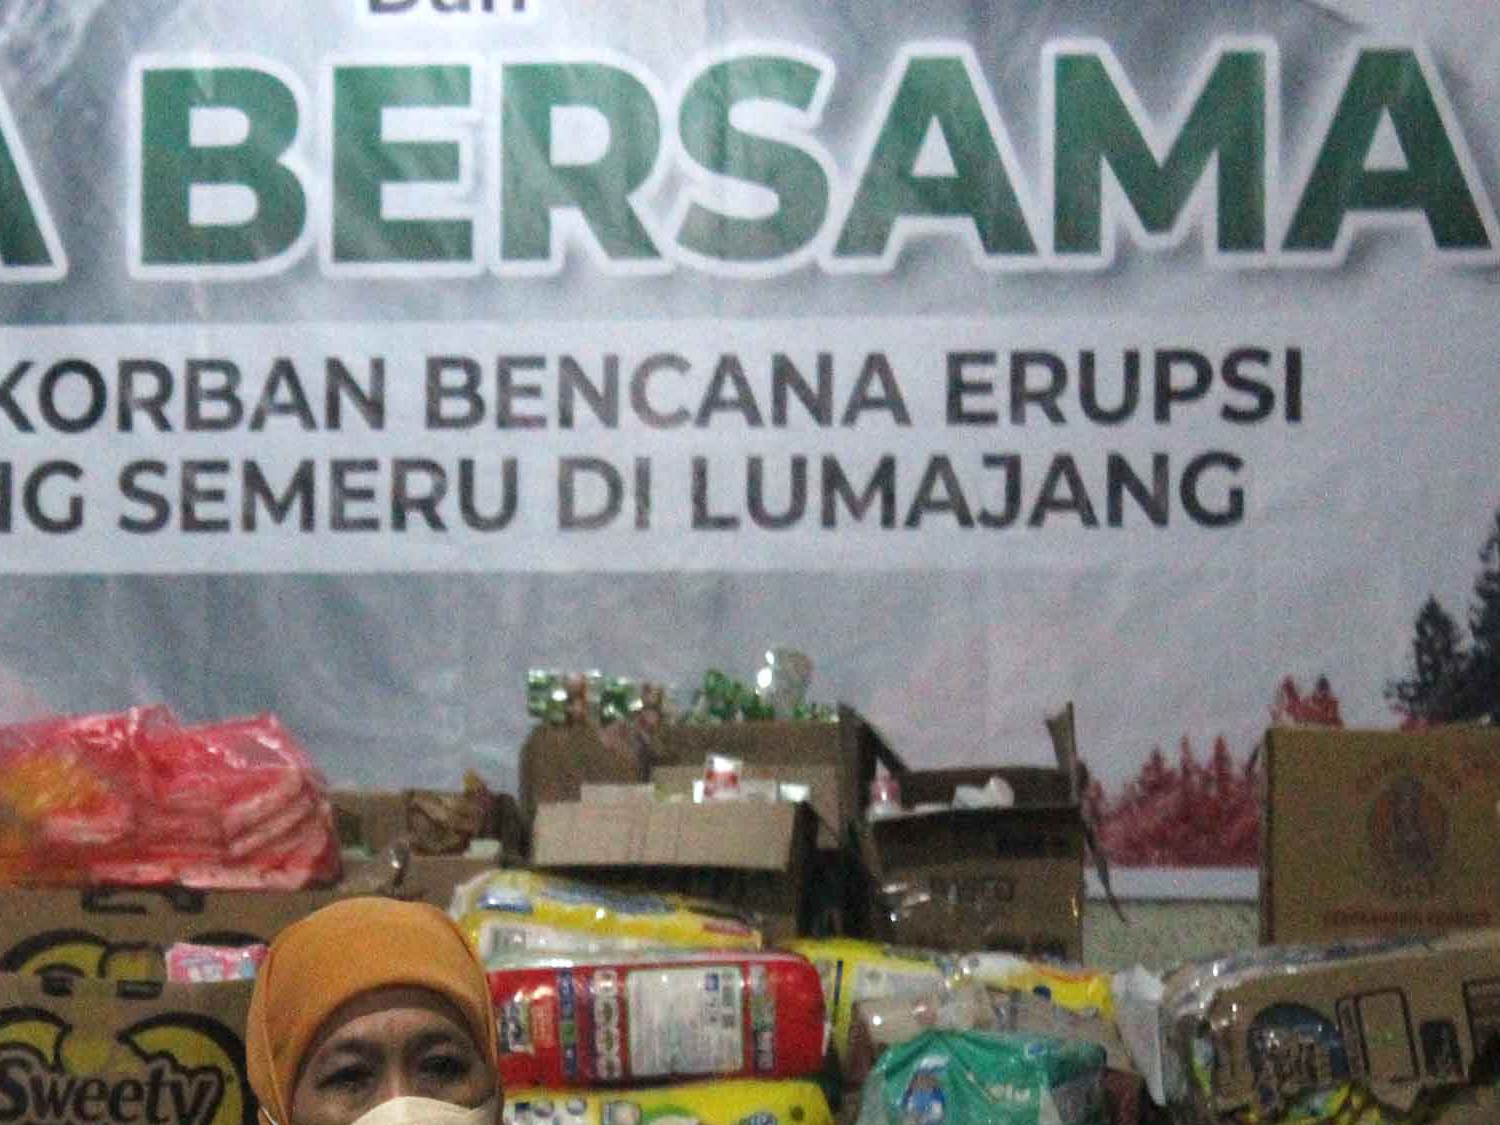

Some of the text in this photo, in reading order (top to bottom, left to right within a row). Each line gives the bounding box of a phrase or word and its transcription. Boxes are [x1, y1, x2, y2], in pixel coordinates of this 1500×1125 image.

[137, 46, 1496, 266] BERSAMA
[425, 351, 914, 431] BENCANA
[945, 346, 1303, 427] ERUPSI
[117, 456, 519, 534] SEMERU
[557, 454, 652, 531] DI
[691, 450, 1247, 530] LUMAJANG
